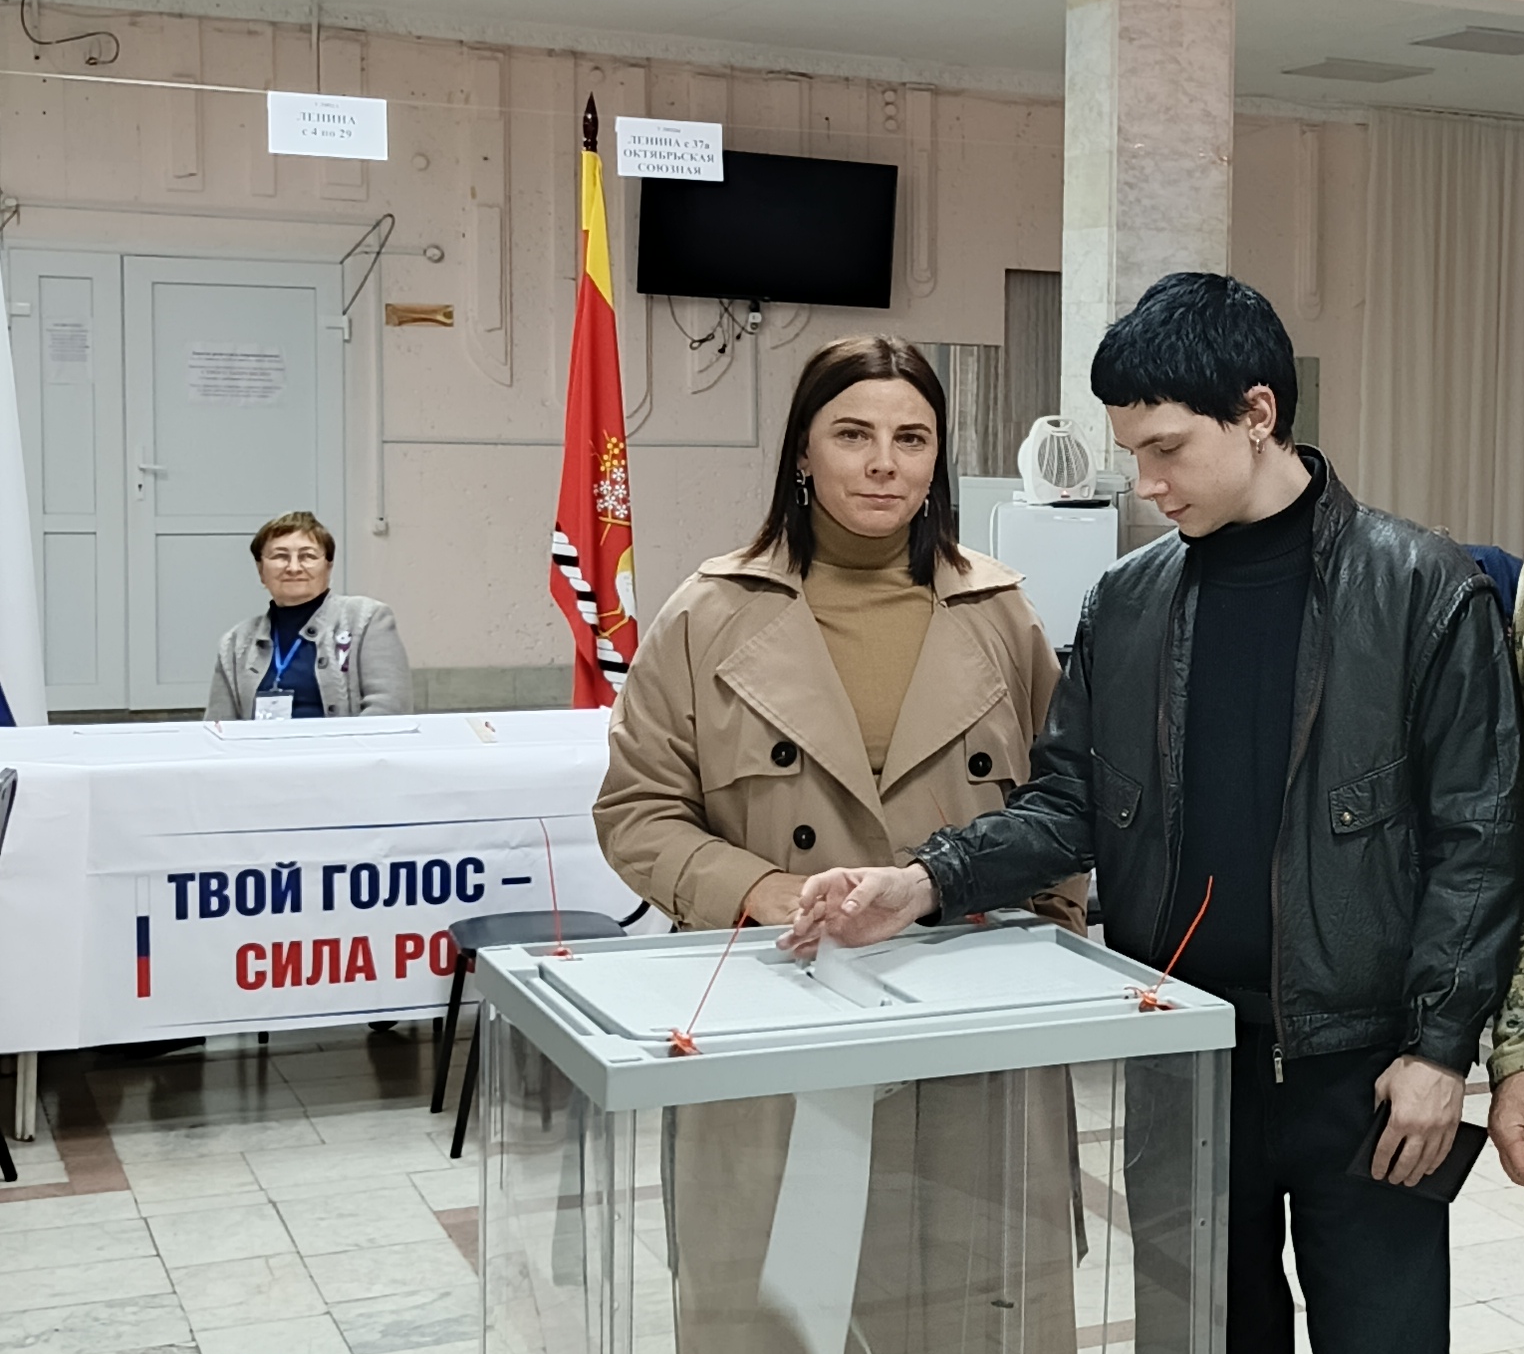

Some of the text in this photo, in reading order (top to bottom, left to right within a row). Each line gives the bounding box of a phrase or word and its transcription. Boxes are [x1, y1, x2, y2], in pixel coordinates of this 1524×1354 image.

[297, 112, 356, 125] ЛЕНИНА
[311, 128, 318, 136] 4
[339, 129, 352, 138] 29
[628, 135, 681, 148] ЛЕНИНА
[623, 148, 715, 163] ОКТЯБРЬСКАЯ
[637, 163, 702, 175] СОЮЗНАЯ
[167, 861, 302, 920] ТВОЙ
[322, 857, 486, 911] ГОЛОС
[236, 929, 475, 991] СИЛА РО
